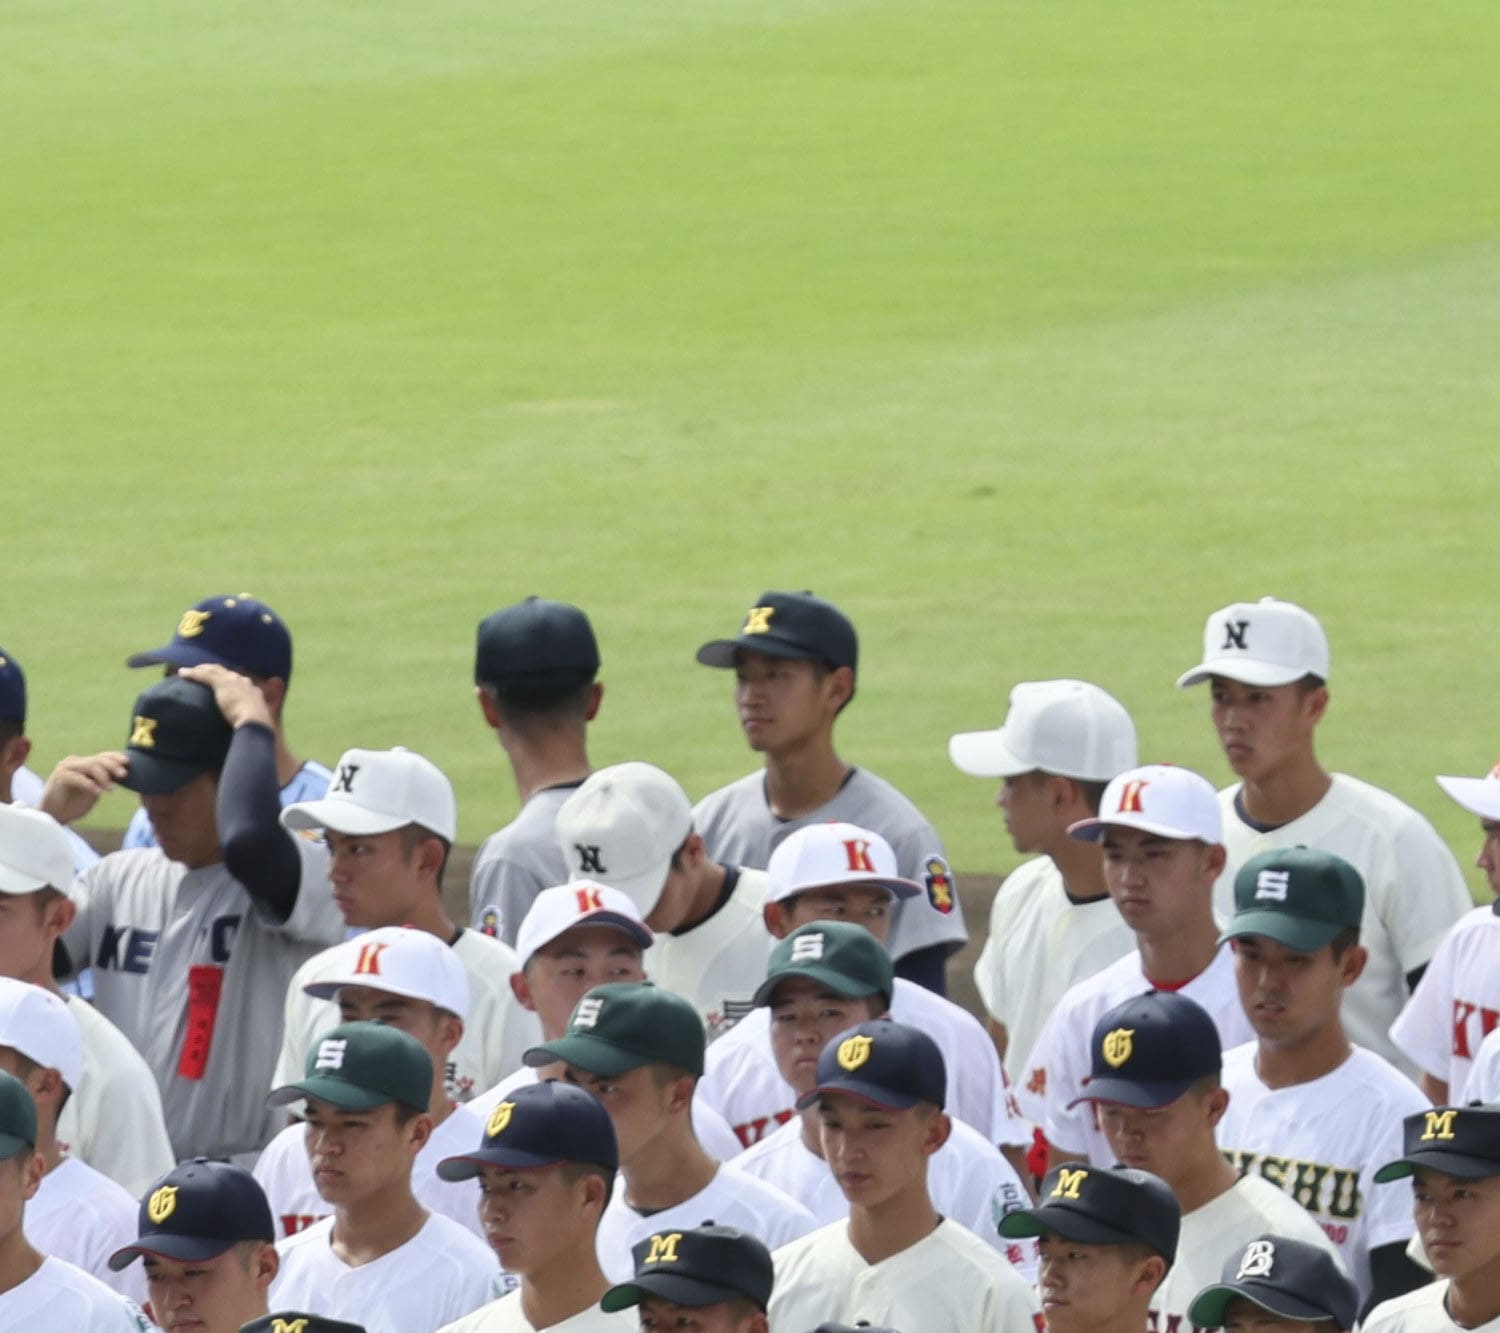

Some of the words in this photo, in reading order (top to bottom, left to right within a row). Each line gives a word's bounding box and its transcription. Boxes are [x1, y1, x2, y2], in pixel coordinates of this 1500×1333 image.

[743, 605, 776, 634] K
[1221, 619, 1251, 650] N
[574, 844, 606, 875] N
[845, 839, 875, 872] K
[97, 914, 238, 973] KEO
[645, 1232, 681, 1263] M
